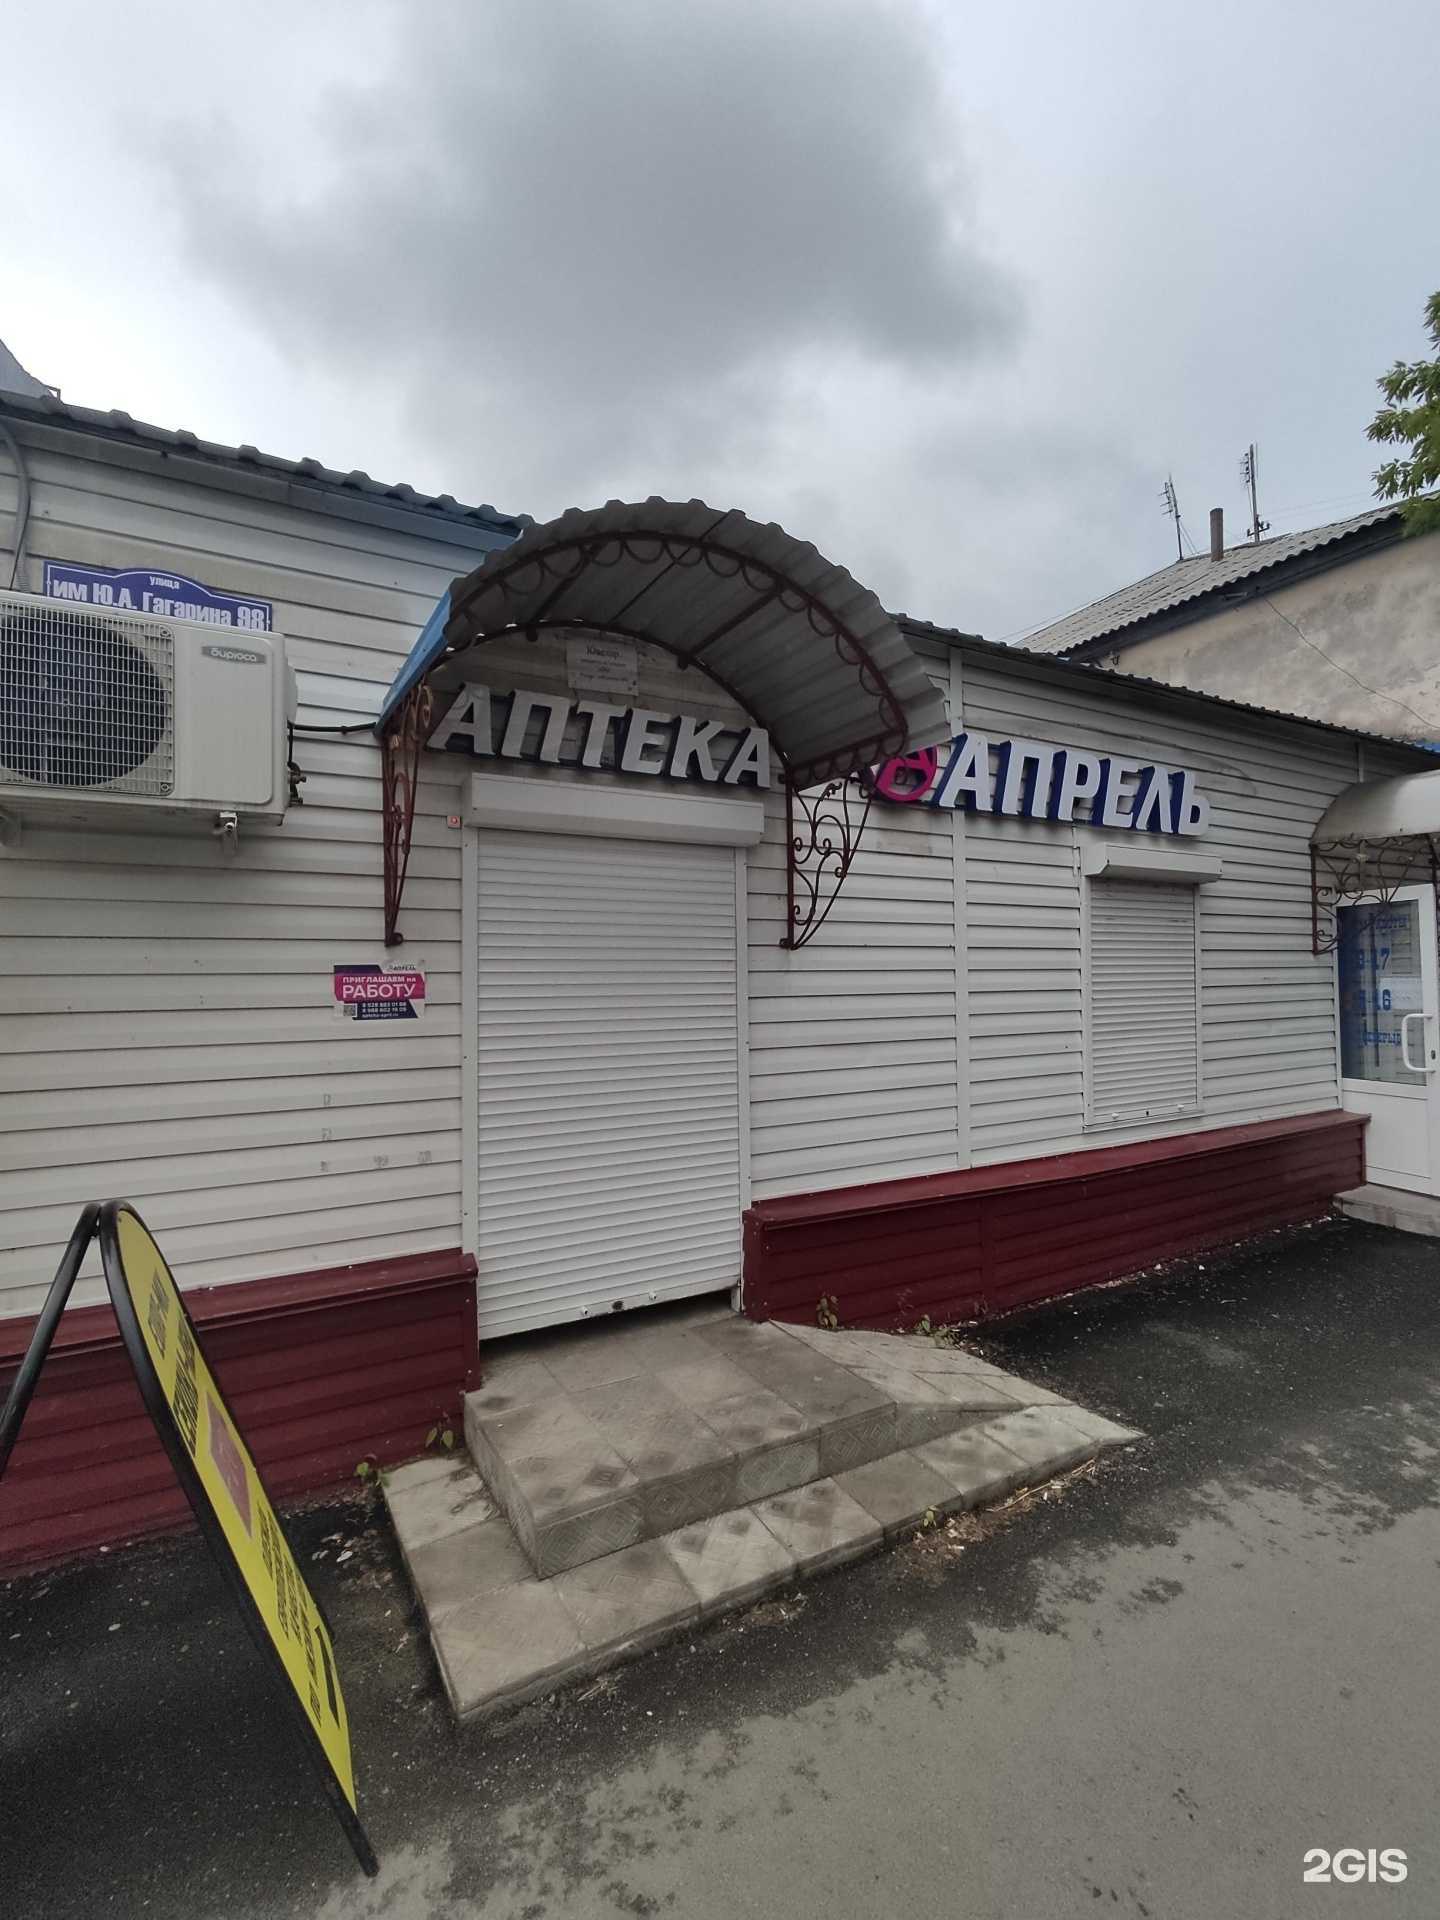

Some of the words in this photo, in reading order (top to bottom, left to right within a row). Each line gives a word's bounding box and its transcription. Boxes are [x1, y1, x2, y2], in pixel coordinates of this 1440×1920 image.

[149, 575, 180, 590] улица
[53, 579, 88, 601] им
[92, 580, 137, 610] Ю.А.
[143, 592, 232, 626] Гагарина
[237, 605, 265, 632] 98
[426, 681, 771, 788] АПТЕКА
[935, 732, 1210, 836] АПРЕЛЬ
[342, 975, 405, 984] ПРИГЛАШАЕМ
[342, 984, 416, 999] РАБОТУ
